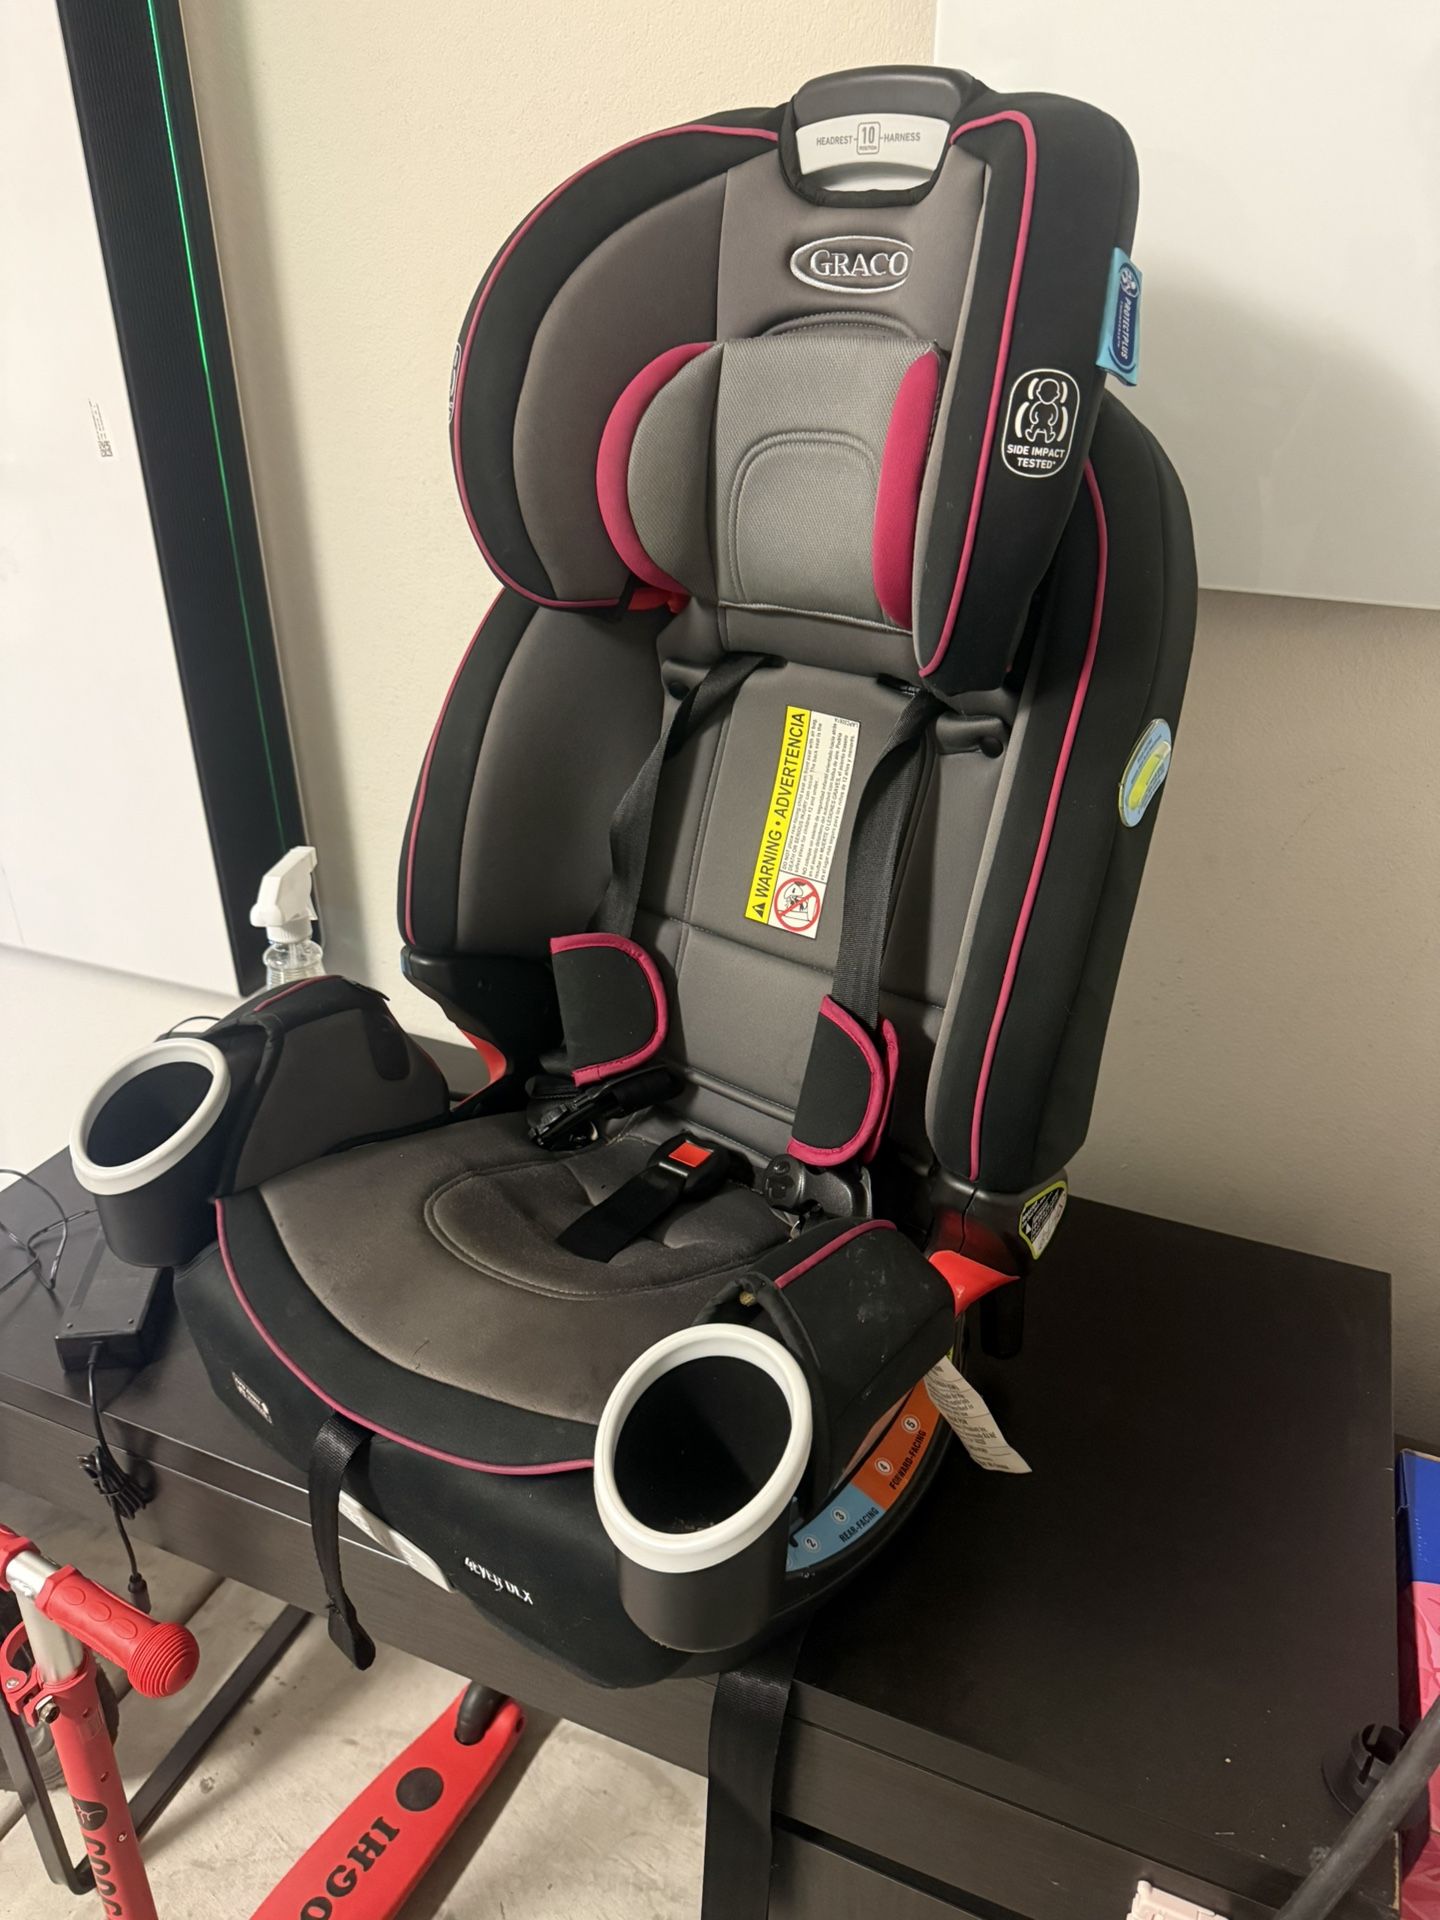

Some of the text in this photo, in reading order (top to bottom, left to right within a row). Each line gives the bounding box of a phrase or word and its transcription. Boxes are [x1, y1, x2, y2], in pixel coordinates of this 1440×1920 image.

[816, 126, 921, 146] HEADREST 10 HARNESS
[810, 250, 908, 277] GRACO
[1120, 297, 1132, 360] PROTECTPLUS
[1006, 444, 1066, 458] SIDE IMPACT
[755, 713, 806, 898] WARNING ADVERTENCIA
[889, 1430, 928, 1490] FORWARD-FACING
[838, 1506, 880, 1542] REAR-FACING
